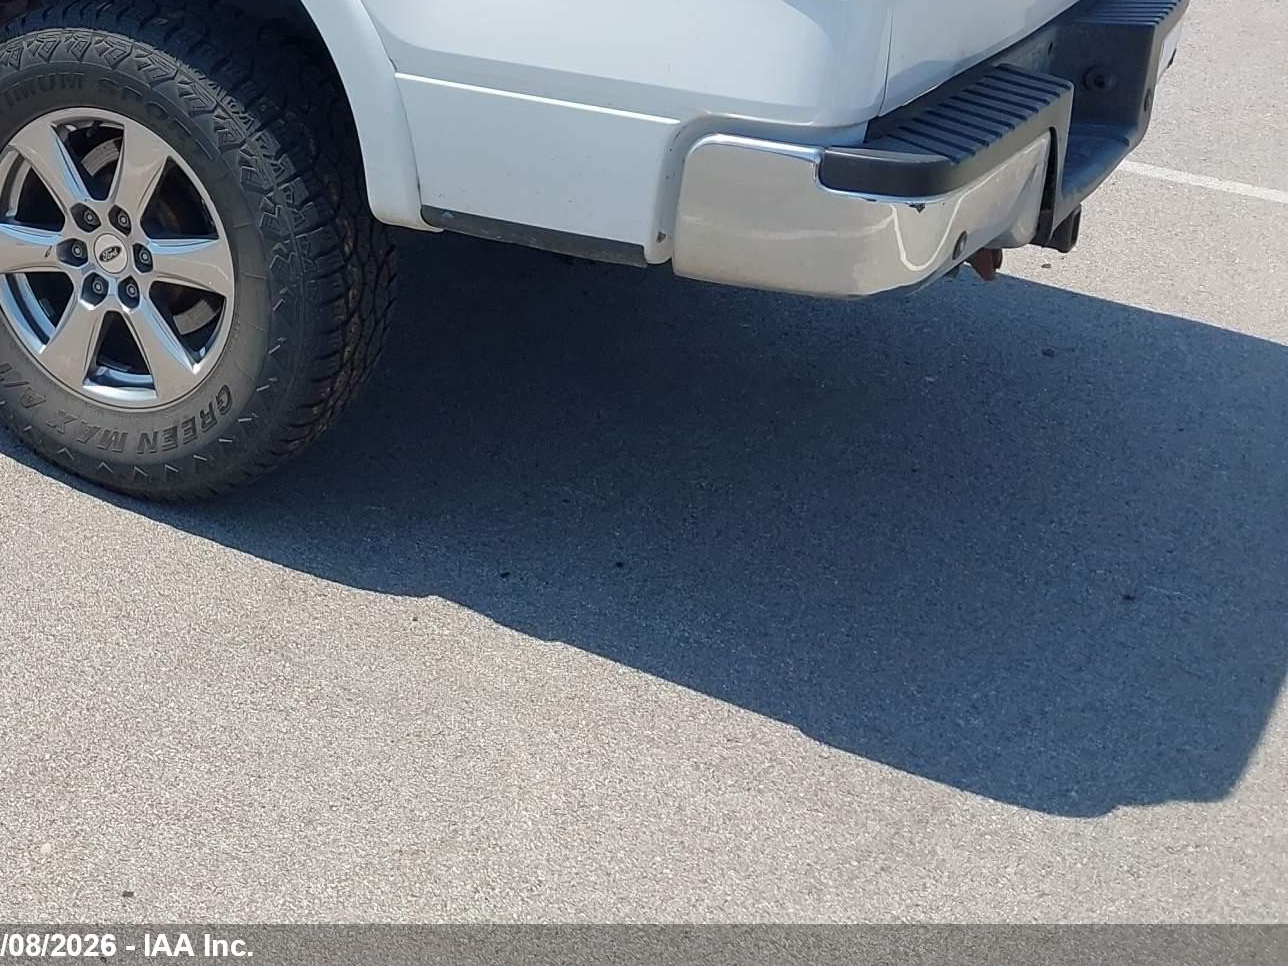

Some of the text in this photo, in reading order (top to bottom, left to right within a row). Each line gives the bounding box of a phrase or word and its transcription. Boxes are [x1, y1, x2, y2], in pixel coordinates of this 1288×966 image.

[102, 247, 118, 262] Ford
[47, 409, 128, 454] MAX
[136, 383, 233, 455] GREEN
